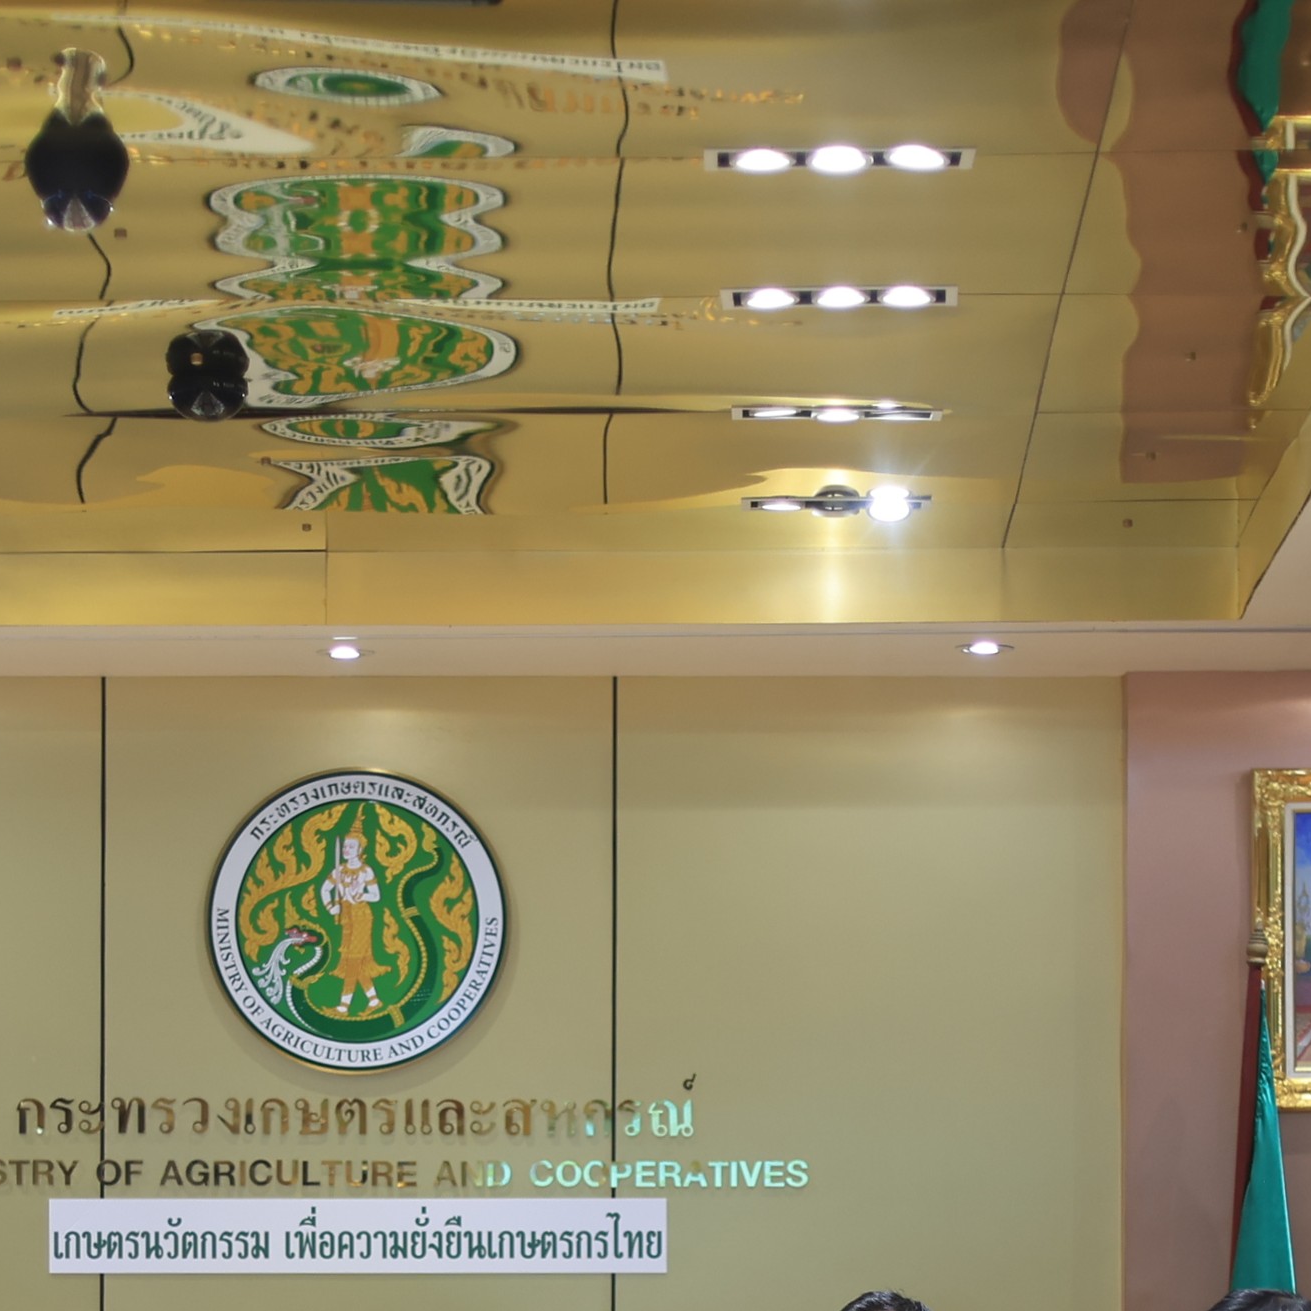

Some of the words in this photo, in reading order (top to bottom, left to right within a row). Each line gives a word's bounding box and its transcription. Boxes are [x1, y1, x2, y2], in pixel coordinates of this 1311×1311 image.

[250, 780, 477, 849] กระทรวงเกษตรและสหกรณ์
[216, 907, 248, 992] MINISTRY
[242, 993, 264, 1018] OF
[259, 1017, 384, 1062] AGRICULTURE
[388, 1033, 425, 1059] AND
[426, 916, 499, 1040] COOPERATIVES
[17, 1074, 696, 1137] กระทรวงเกษตรและสหกรณ์
[96, 1159, 143, 1186] OF
[160, 1159, 417, 1187] AGRICULTURE
[434, 1160, 511, 1187] AND
[530, 1160, 809, 1187] COOPERATIVES
[53, 1217, 270, 1259] เกษตรนวัตกรรม
[286, 1206, 663, 1260] เพื่อความยั่งยืนเกษตรกรไทย
